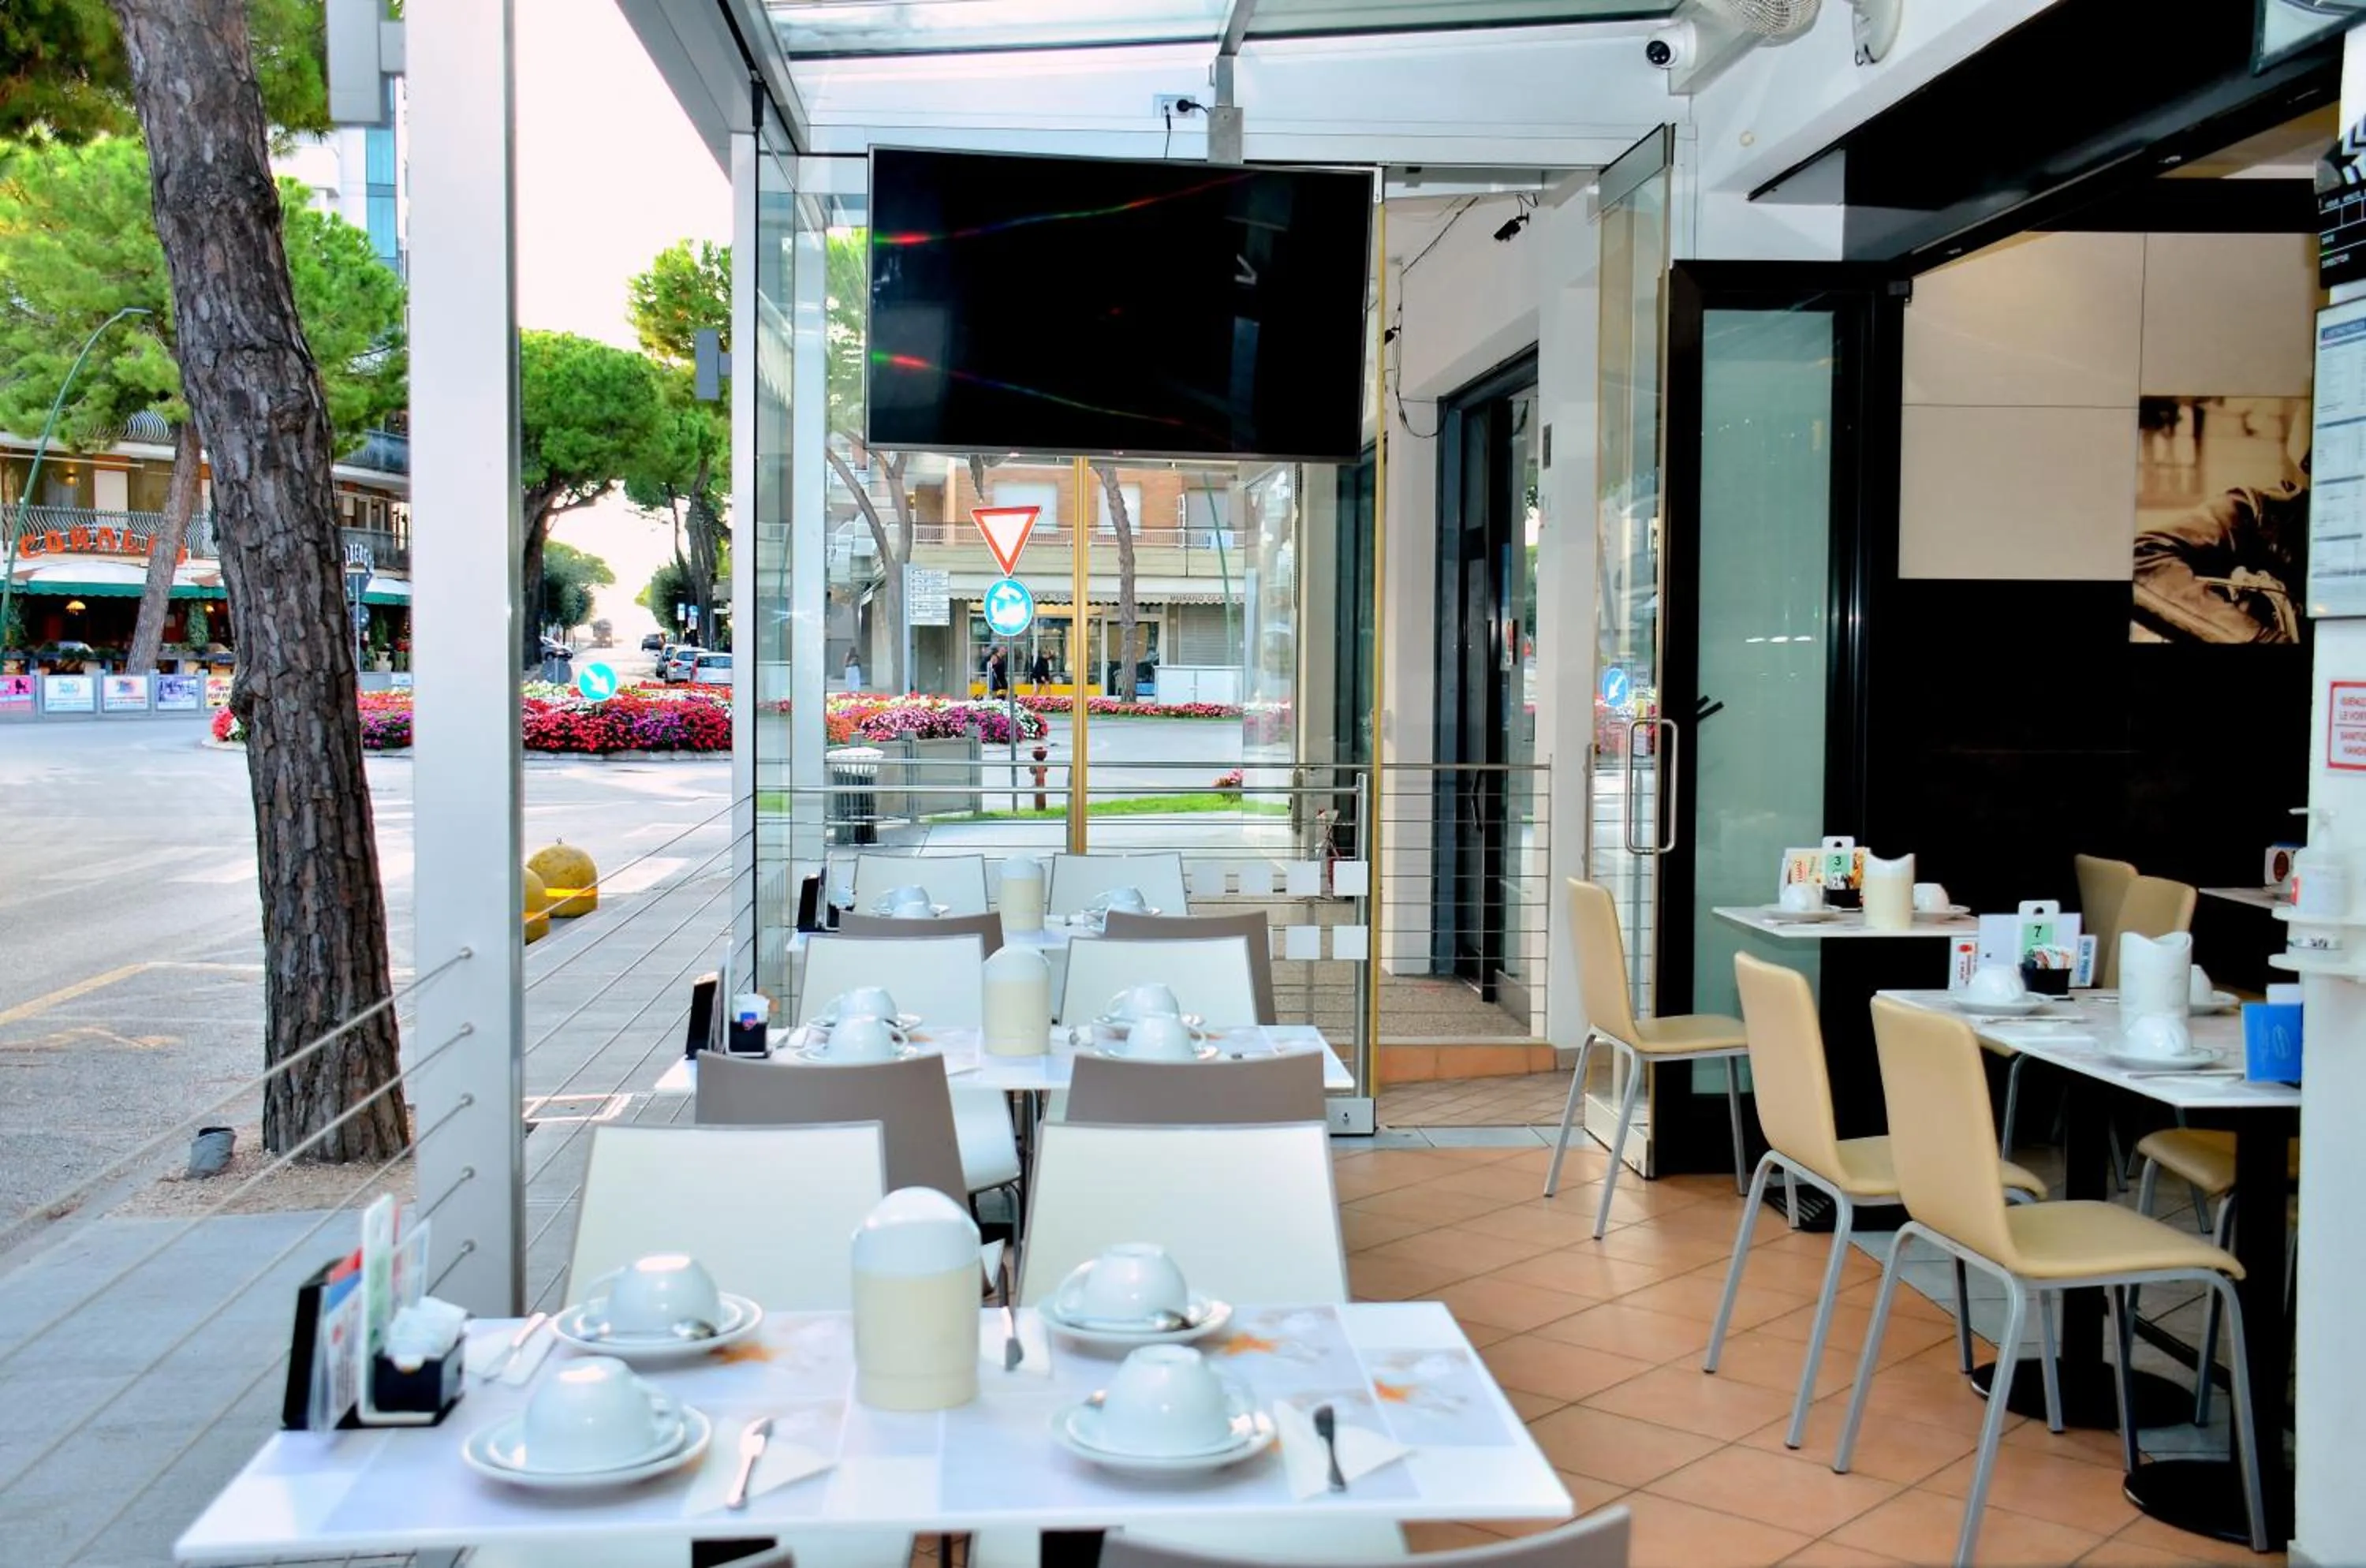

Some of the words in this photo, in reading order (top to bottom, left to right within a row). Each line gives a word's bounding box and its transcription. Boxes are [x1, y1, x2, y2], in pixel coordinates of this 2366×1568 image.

[19, 525, 188, 566] CORAL
[1834, 856, 1842, 866] 3
[2034, 925, 2042, 938] 7
